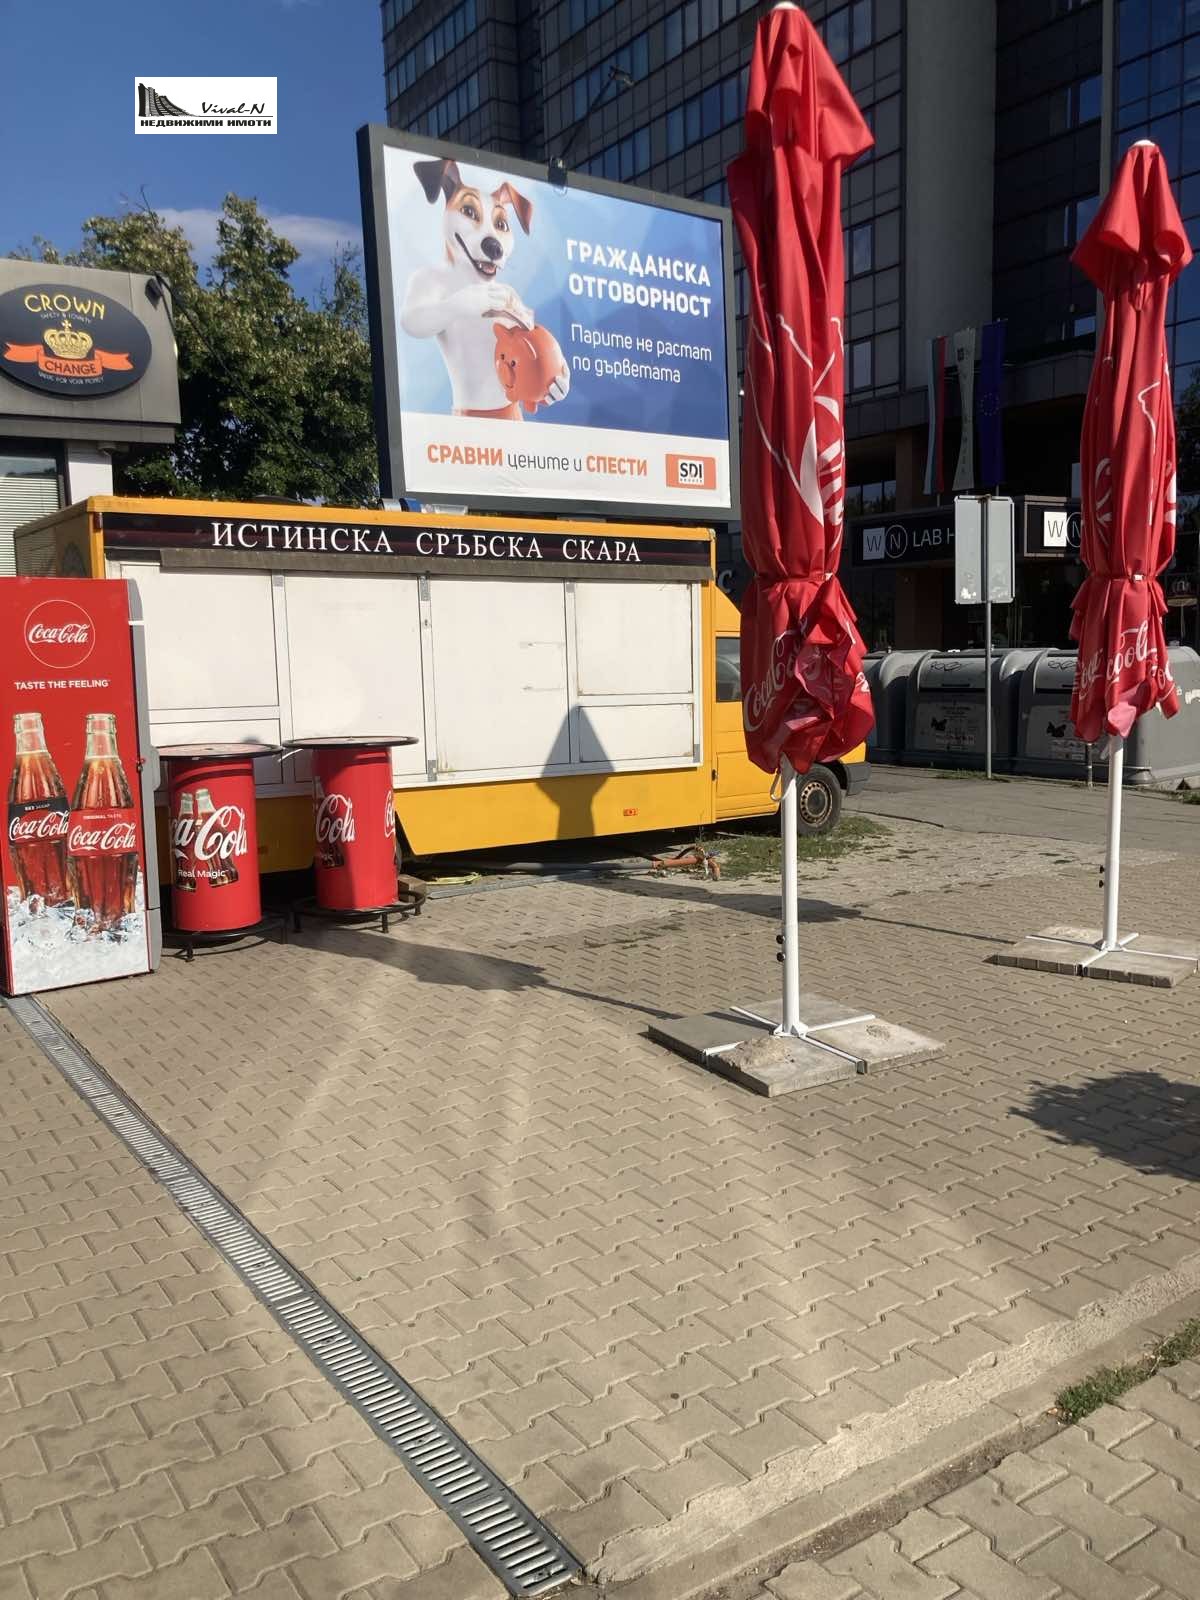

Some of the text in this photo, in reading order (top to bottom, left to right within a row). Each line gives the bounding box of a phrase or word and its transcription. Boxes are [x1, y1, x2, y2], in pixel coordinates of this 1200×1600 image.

[566, 239, 711, 287] ГРАЖДАНСКА
[24, 294, 105, 320] CROWN
[568, 273, 711, 318] ОТГОВОРНОСТ
[571, 323, 712, 362] Парите не растат
[44, 360, 97, 375] CHANGE
[573, 355, 681, 383] по дърветата
[427, 444, 648, 477] СРАВНИ цените и СПЕСТИ
[680, 462, 702, 479] SDI
[211, 522, 642, 562] ИСТИНСКА СРЪБСКА СКАРА
[912, 529, 942, 547] LAB
[29, 623, 90, 643] Coca-Cola
[14, 680, 108, 690] TASTE THE FEELING
[9, 810, 69, 841] Coca-Cola
[69, 823, 136, 851] Coca-Cola
[197, 869, 226, 879] Magic
